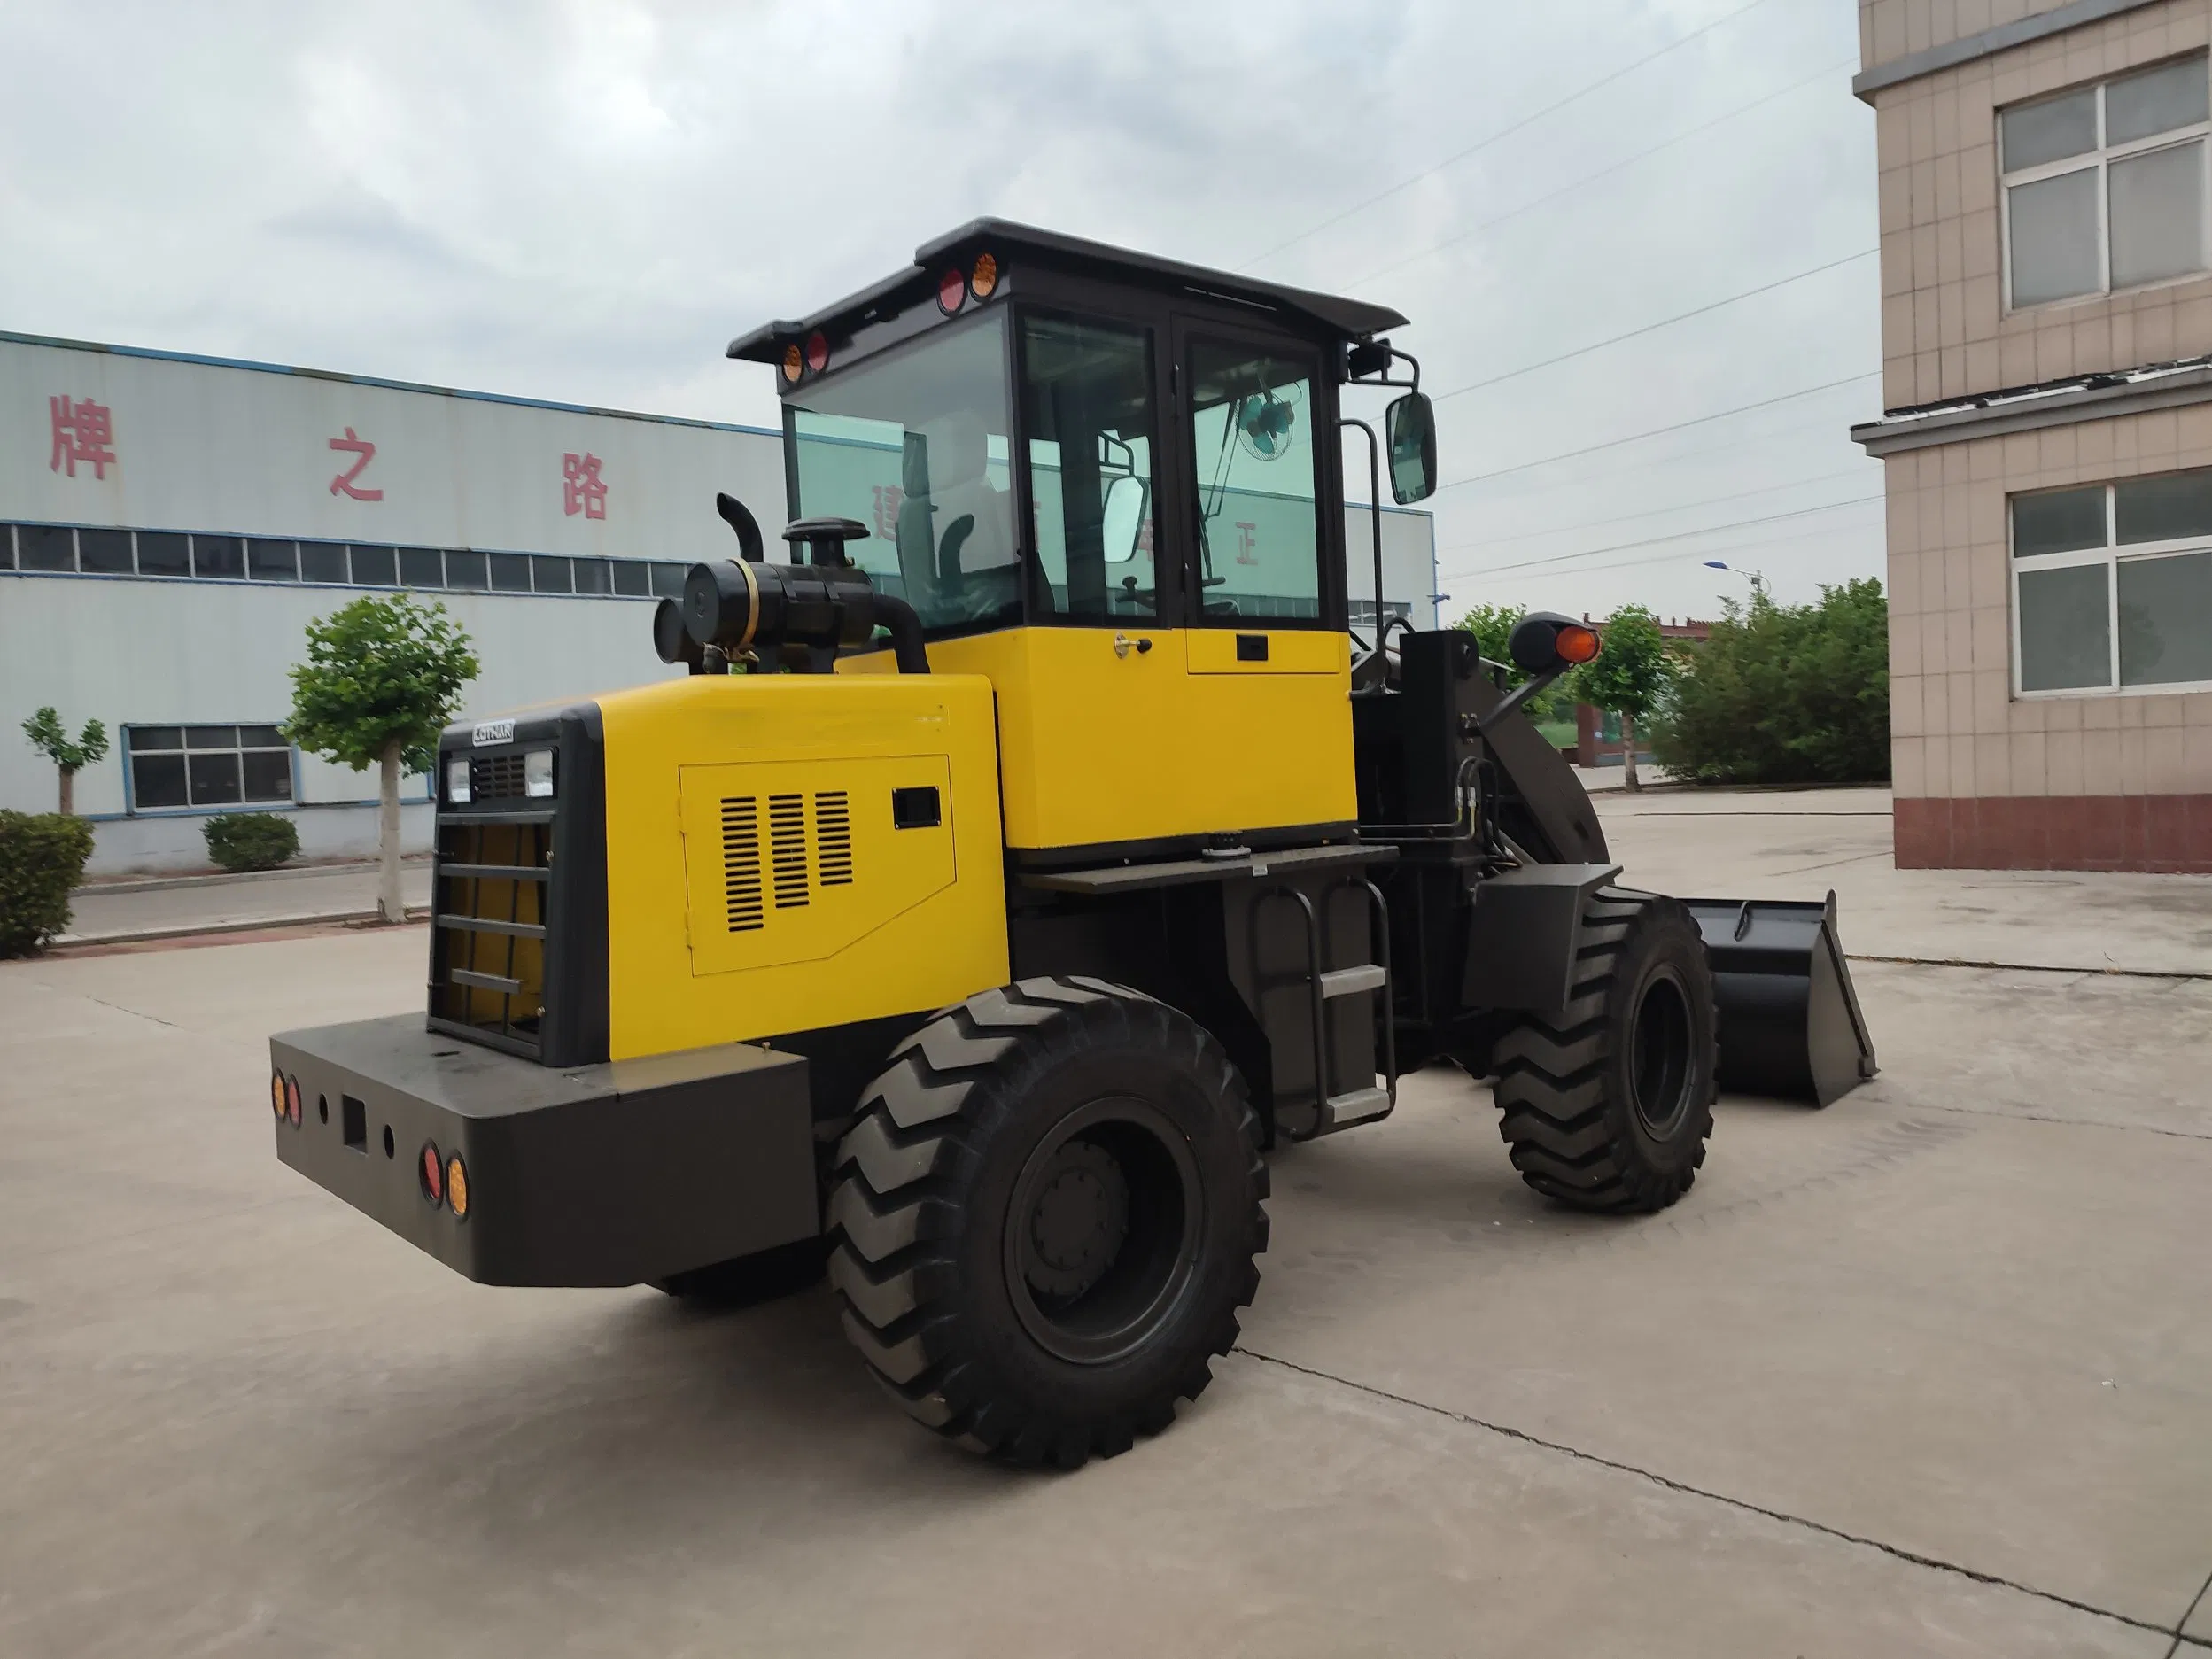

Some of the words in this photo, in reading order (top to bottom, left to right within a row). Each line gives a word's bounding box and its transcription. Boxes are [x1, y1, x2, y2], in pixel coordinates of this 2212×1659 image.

[50, 394, 116, 480] 牌
[330, 426, 384, 501] 之
[563, 452, 608, 520] 路
[1235, 521, 1259, 566] 正
